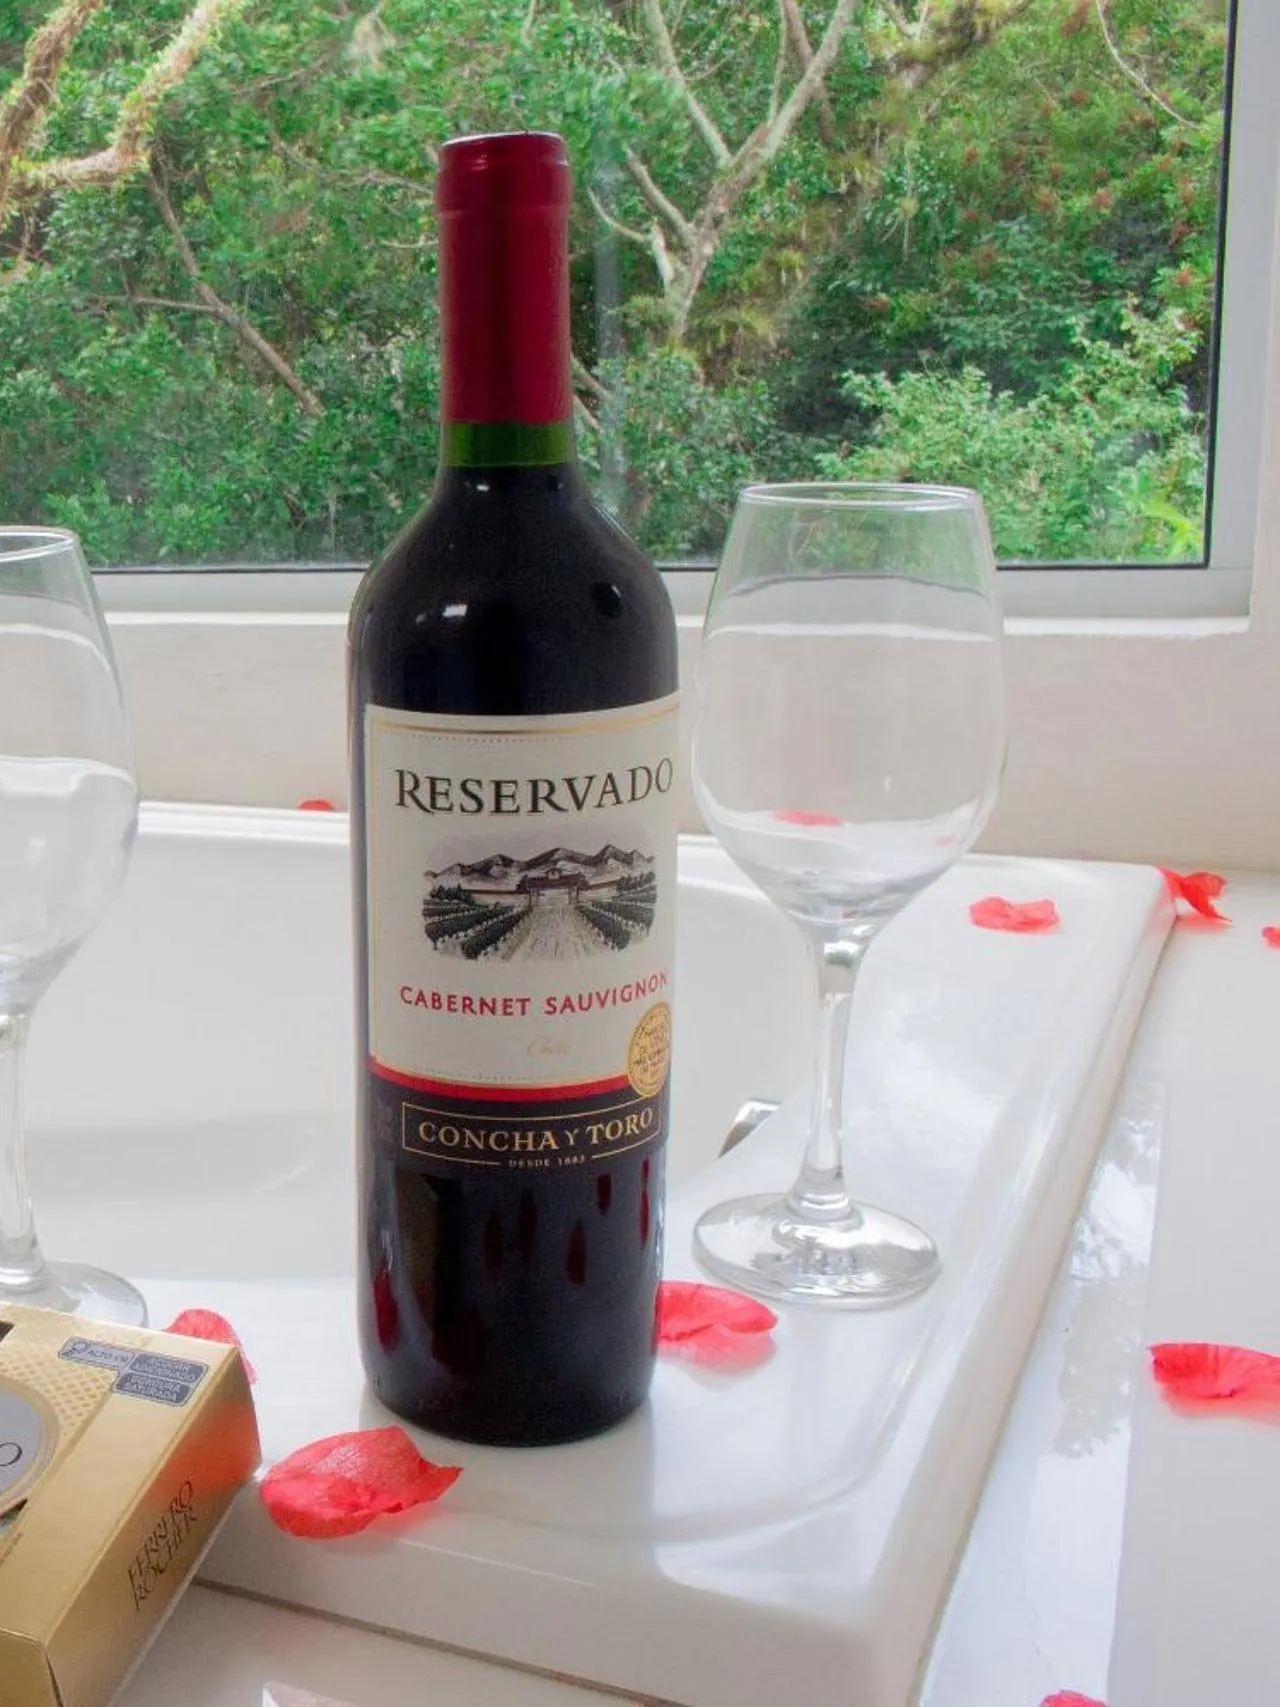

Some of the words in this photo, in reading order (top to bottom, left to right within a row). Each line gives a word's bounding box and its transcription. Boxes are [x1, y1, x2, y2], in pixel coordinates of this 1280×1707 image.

[394, 757, 673, 815] RESERVADO
[400, 986, 532, 1016] CABERNET
[544, 970, 668, 1016] SAUVIGNON
[419, 1121, 559, 1151] CONCHA
[562, 1128, 580, 1146] Y
[585, 1107, 653, 1145] TORO
